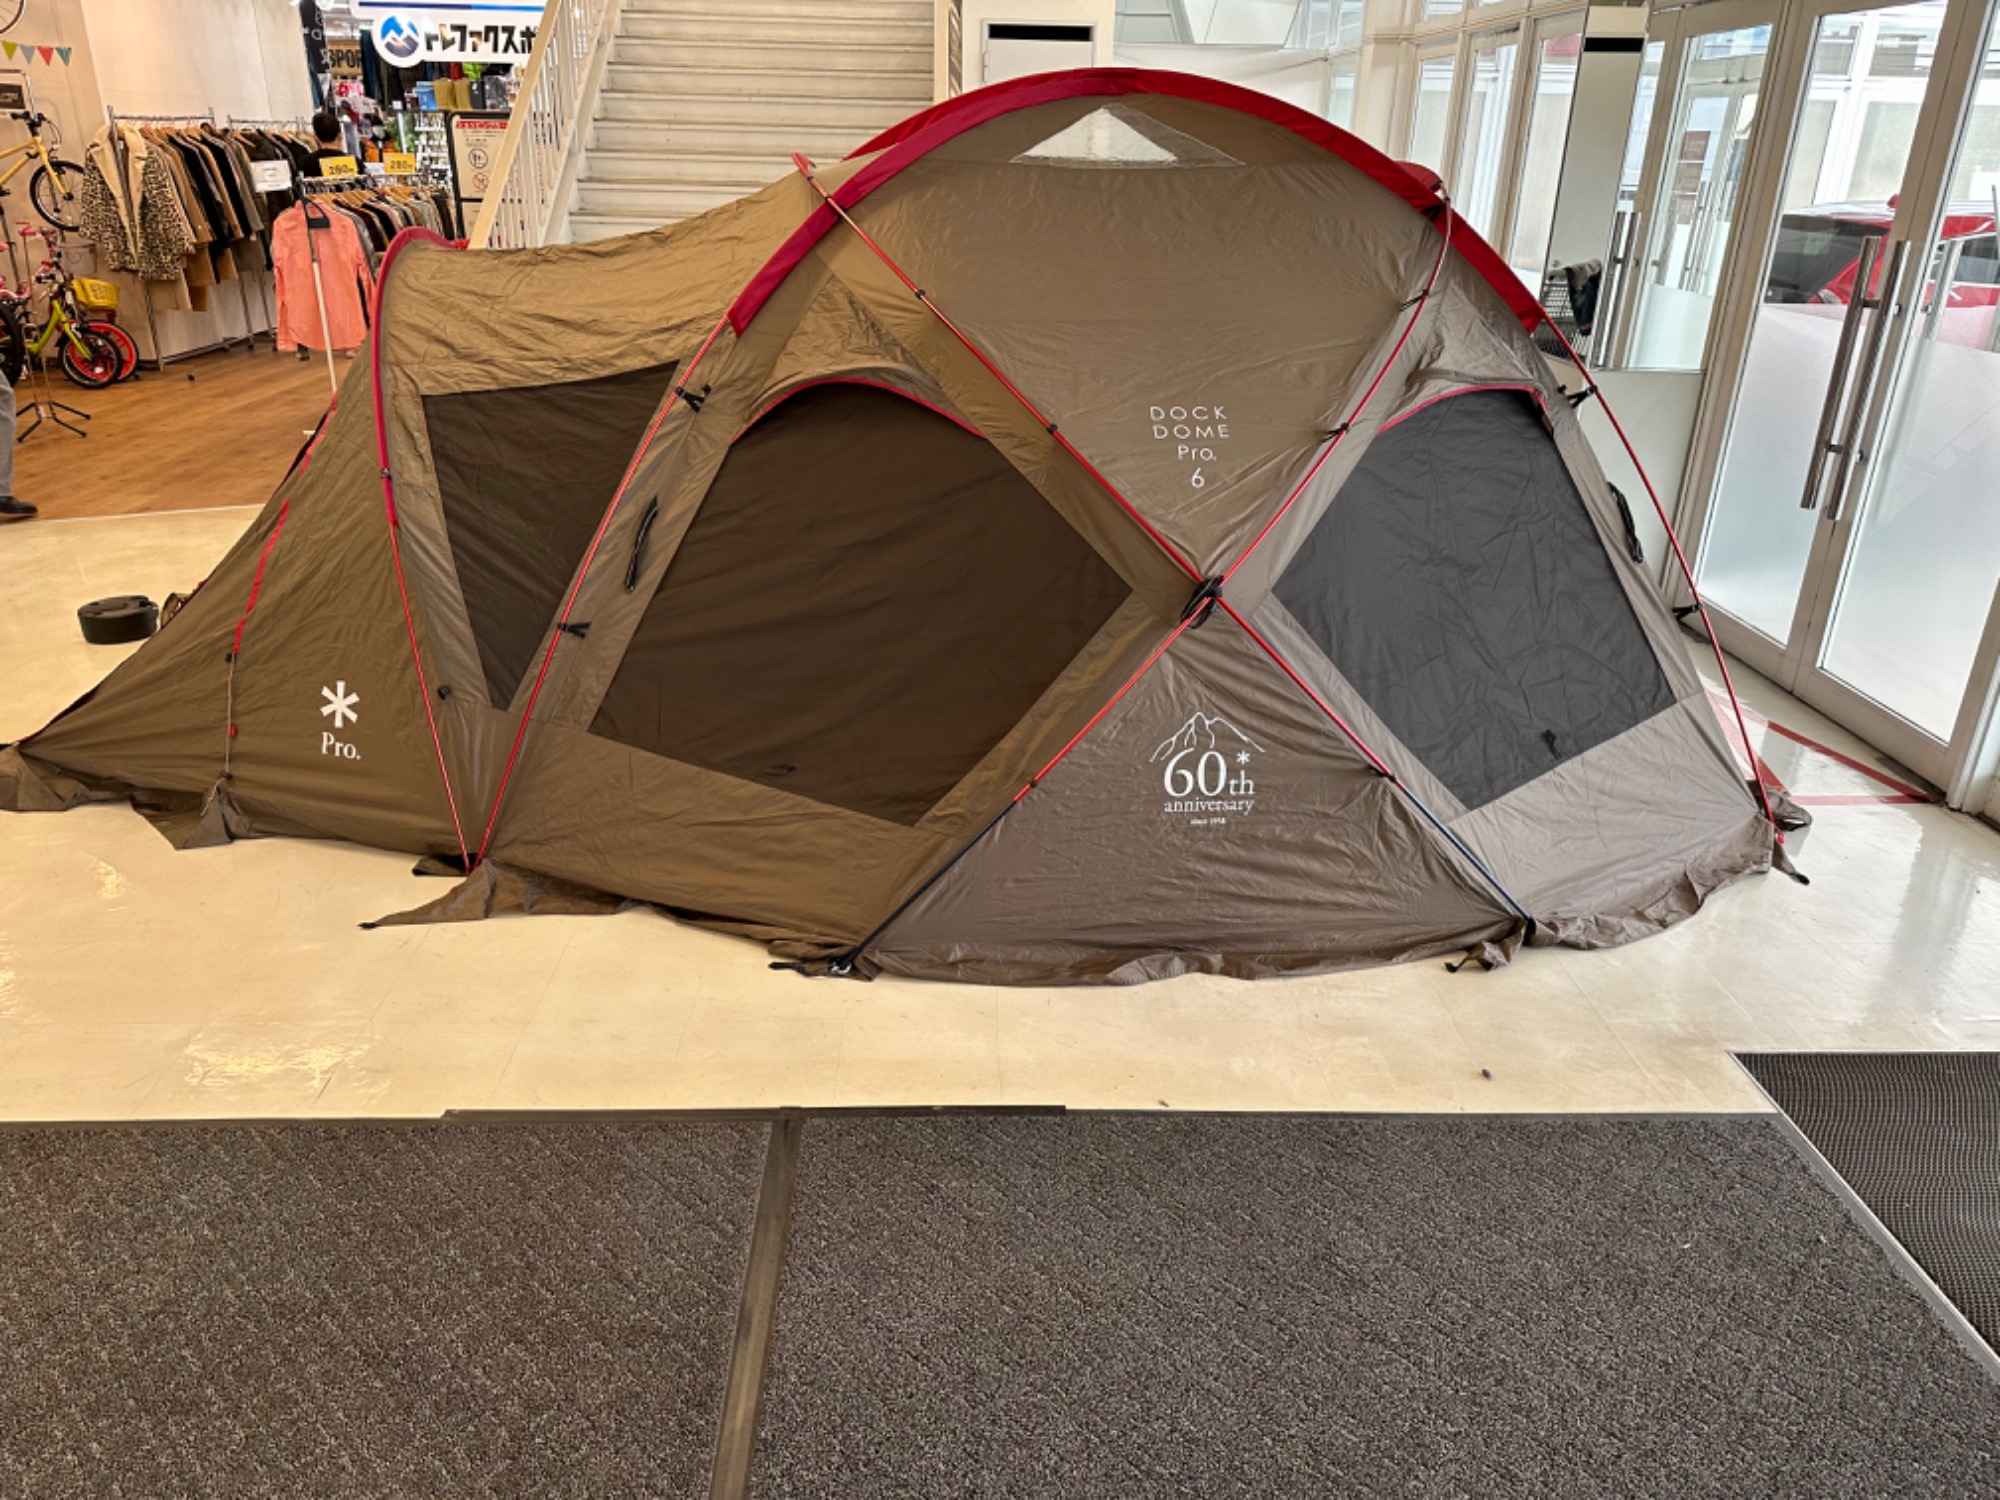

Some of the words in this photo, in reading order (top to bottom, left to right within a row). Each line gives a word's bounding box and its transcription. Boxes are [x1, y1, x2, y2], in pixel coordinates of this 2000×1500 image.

[1149, 405, 1228, 421] DOCK
[1152, 423, 1230, 440] DOME
[1177, 444, 1217, 461] Pro.
[1190, 467, 1206, 489] 6
[321, 731, 361, 761] Pro.
[1163, 747, 1256, 798] 60th
[1163, 797, 1255, 817] anniversary
